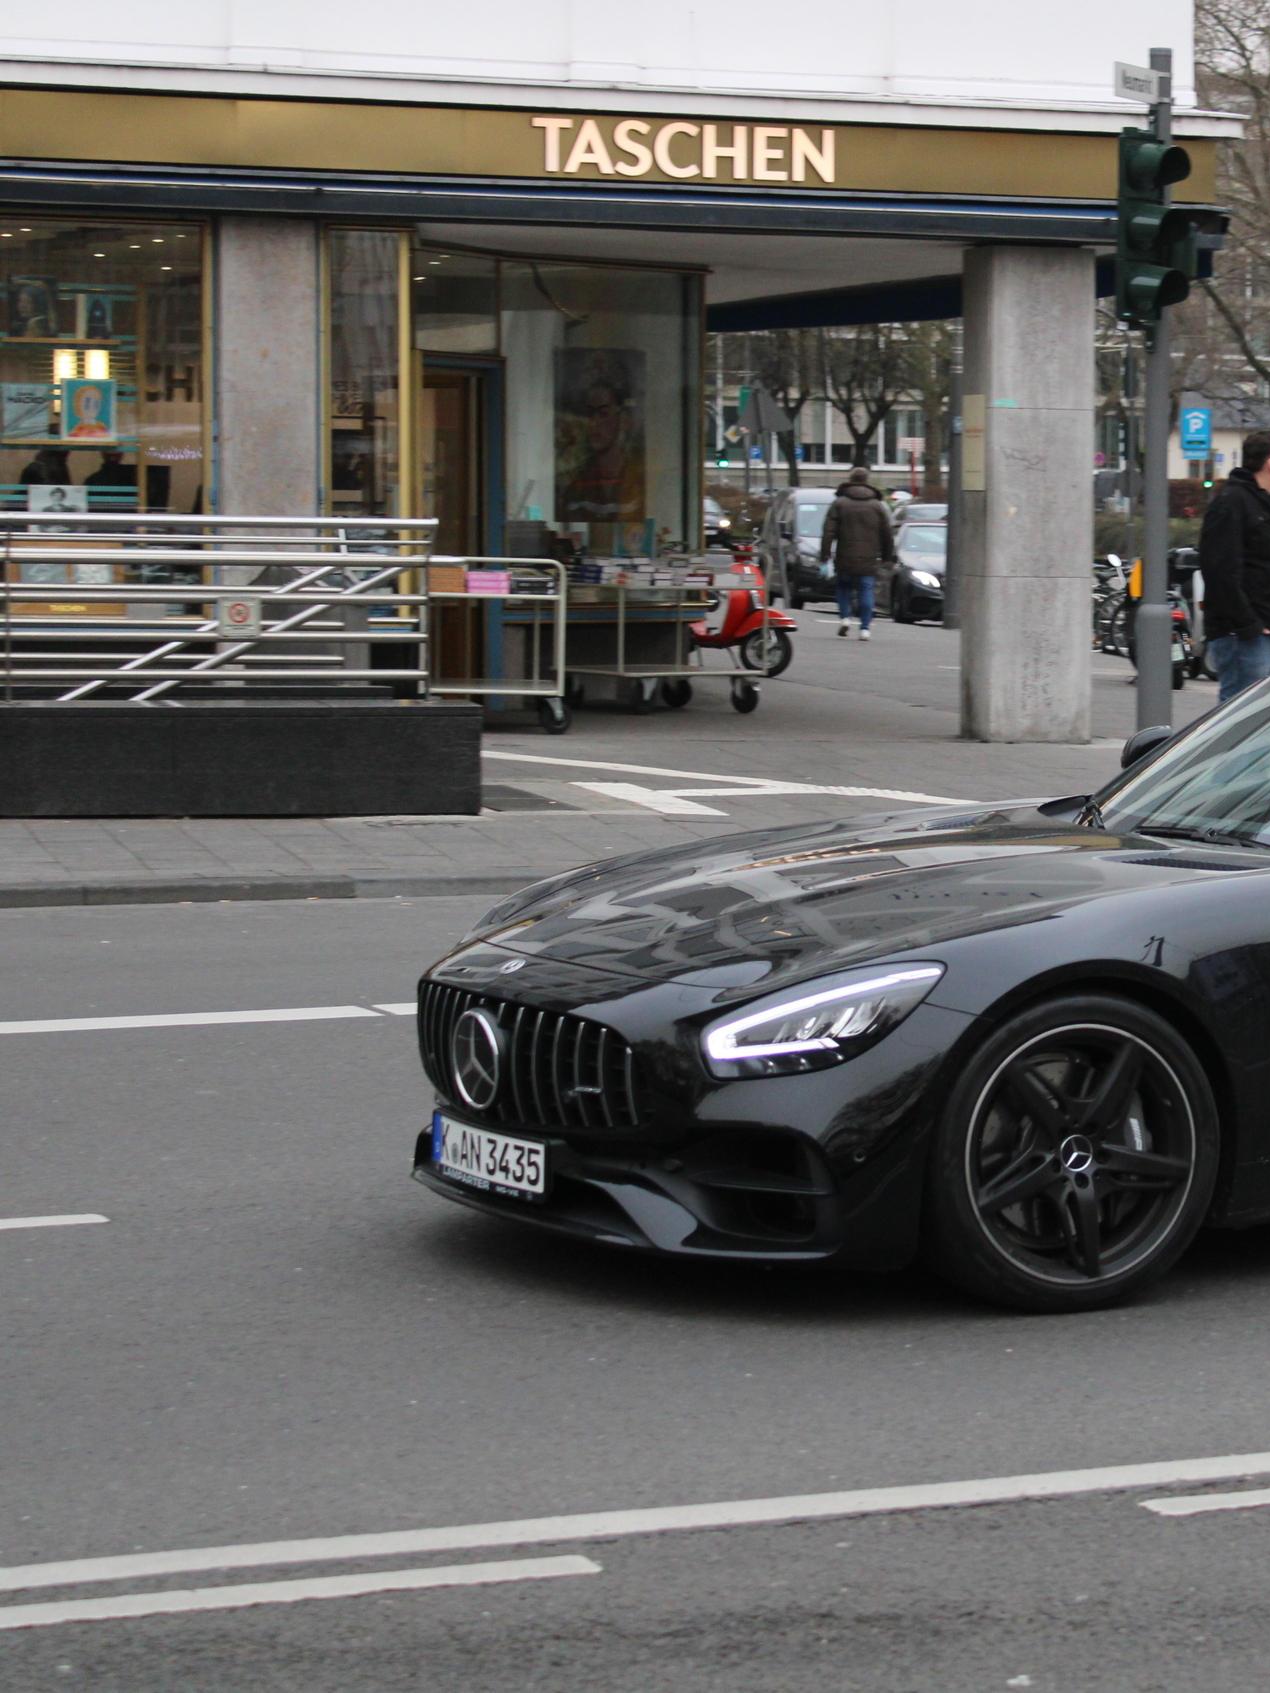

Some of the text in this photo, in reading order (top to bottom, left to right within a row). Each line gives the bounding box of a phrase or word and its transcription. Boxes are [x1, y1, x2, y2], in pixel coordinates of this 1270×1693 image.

[531, 117, 835, 183] TASCHEN
[1189, 418, 1203, 433] P
[443, 1164, 490, 1190] LAMPARTER
[486, 1137, 541, 1186] 3435
